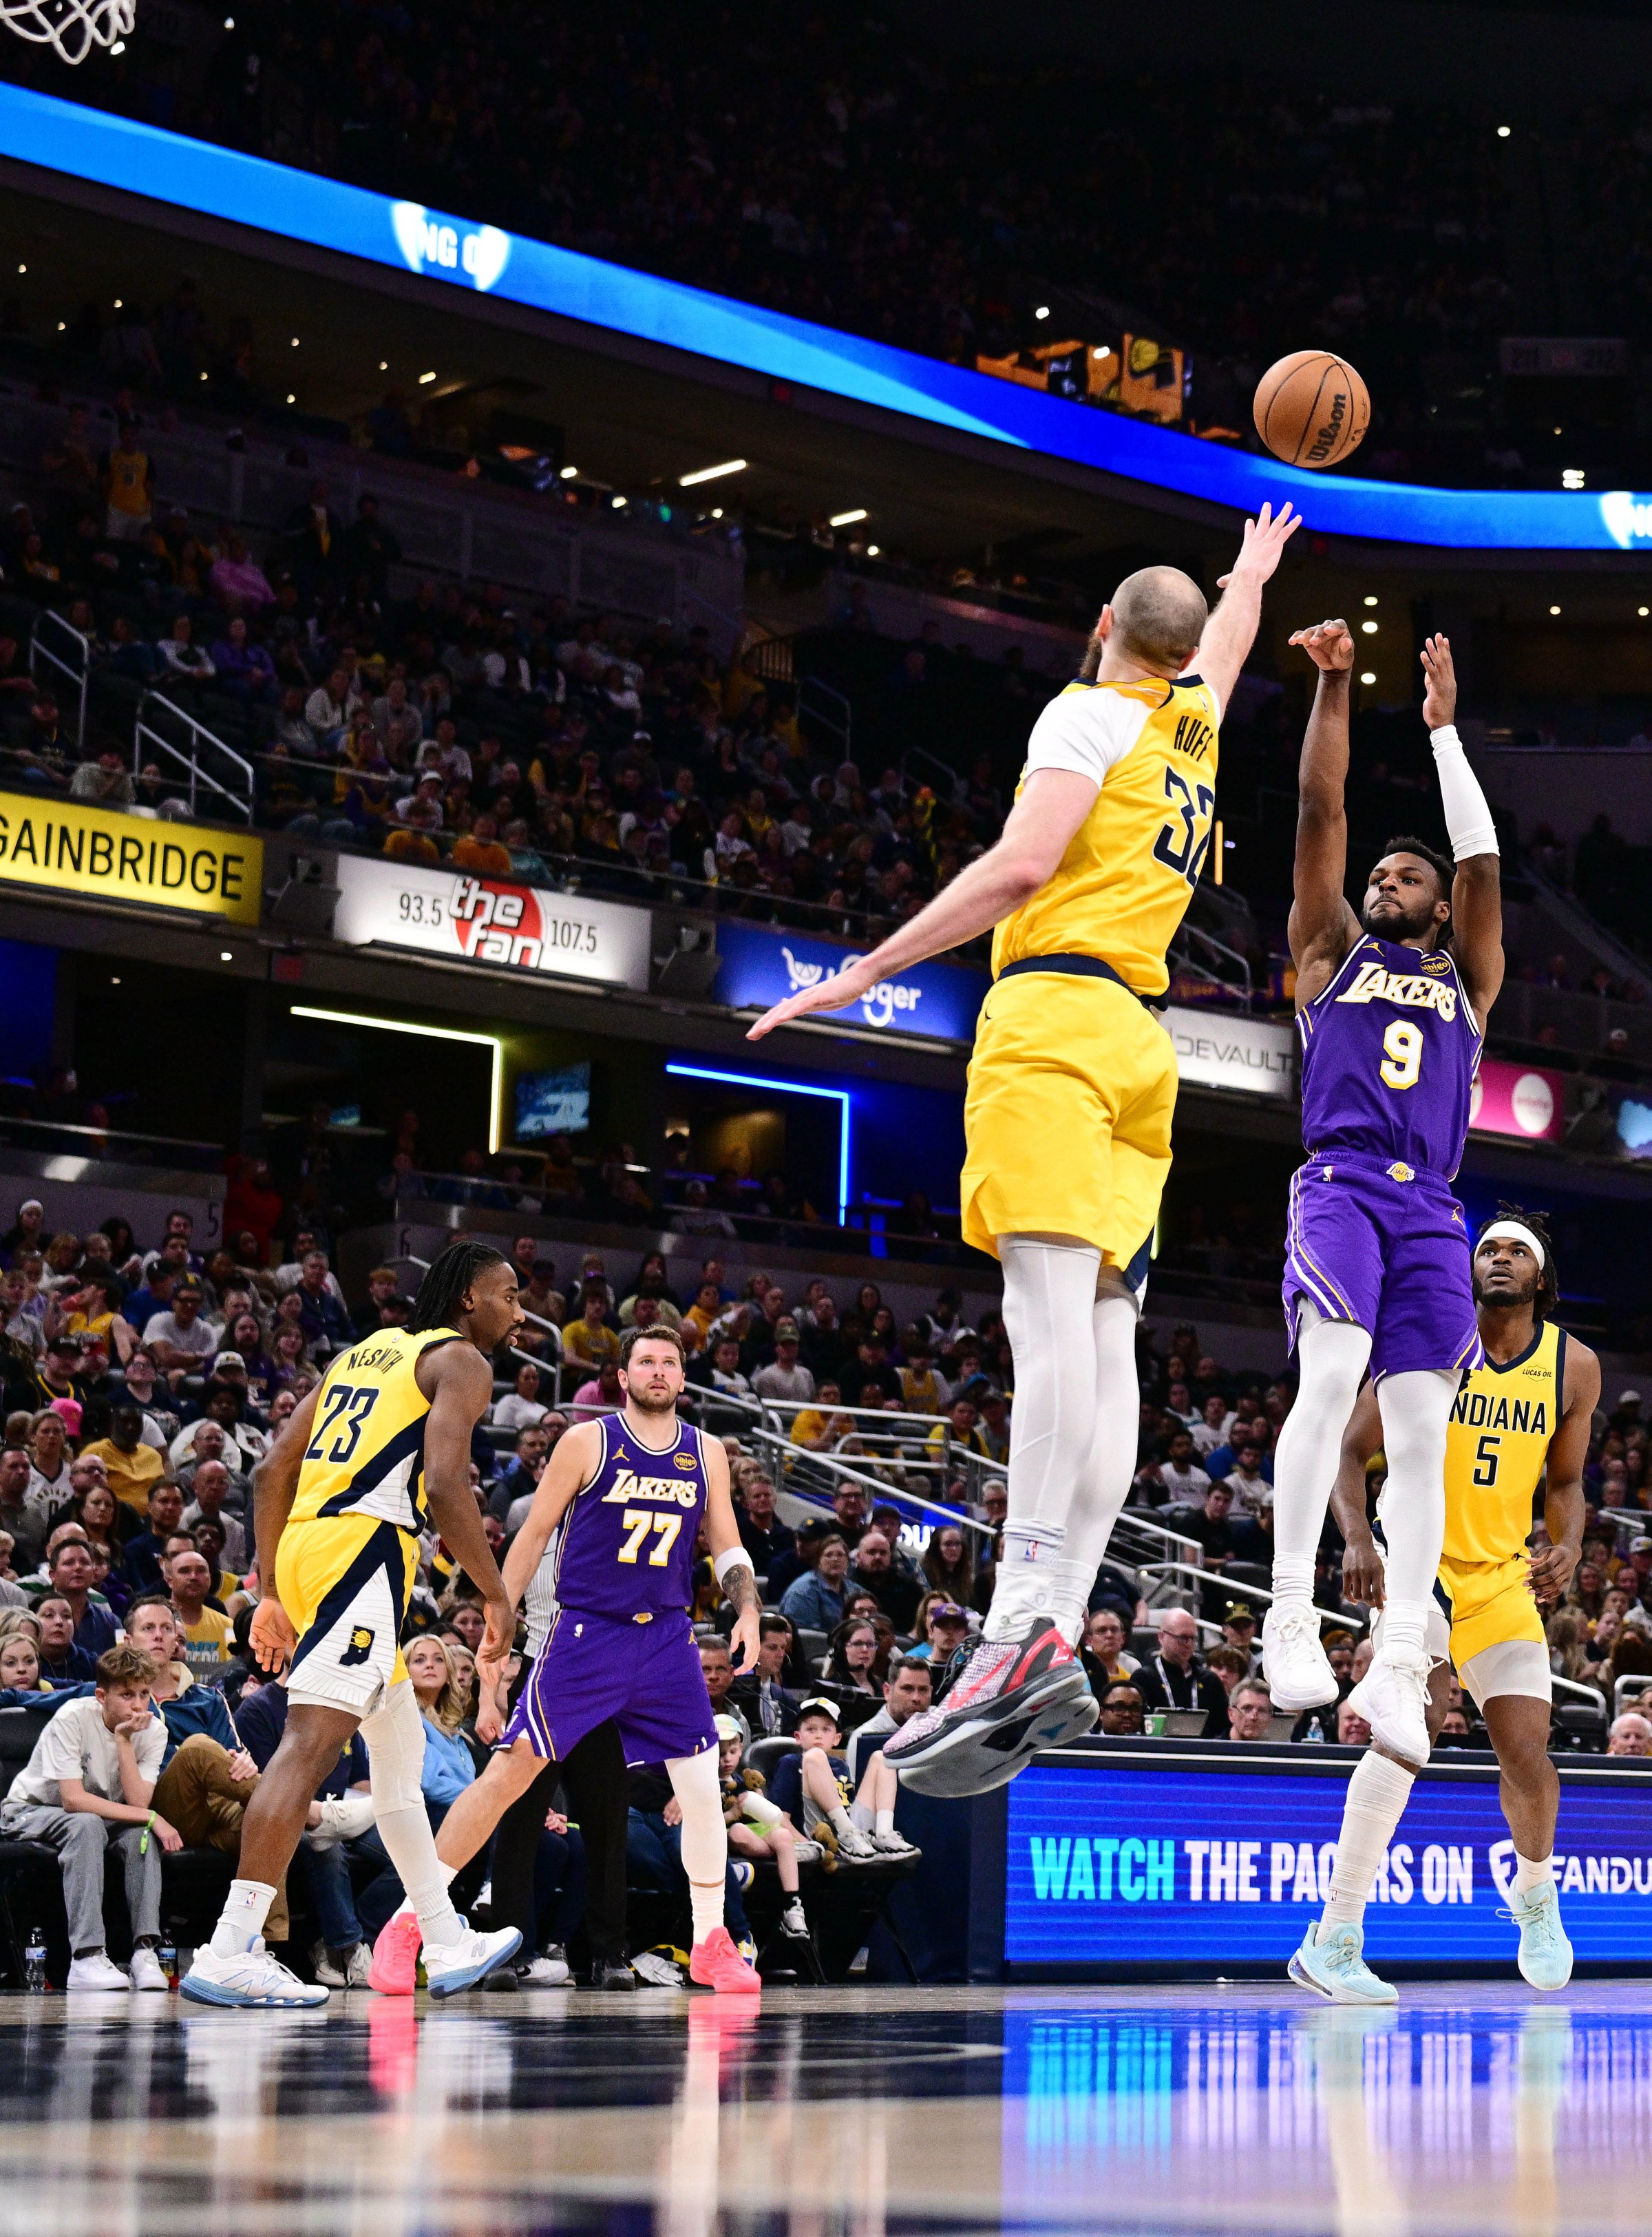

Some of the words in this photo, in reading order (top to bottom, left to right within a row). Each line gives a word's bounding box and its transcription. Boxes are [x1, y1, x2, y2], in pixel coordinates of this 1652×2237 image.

[1305, 393, 1346, 461] Wilson
[400, 893, 441, 926] 93.5
[449, 876, 524, 927] the
[465, 918, 543, 968] fan
[552, 920, 597, 953] 107.5
[1334, 961, 1457, 1022] LAKERS
[1379, 1019, 1424, 1091] 9
[1522, 1368, 1541, 1377] LUCAS
[1542, 1369, 1552, 1378] OIL
[304, 1384, 379, 1463] 23
[1448, 1391, 1547, 1436] NDIANA
[1473, 1435, 1502, 1488] 5
[601, 1468, 698, 1509] LAKERS
[617, 1509, 683, 1567] 77
[1030, 1836, 1175, 1902] WATCH
[1184, 1840, 1262, 1902] THE
[1422, 1844, 1474, 1905] ON
